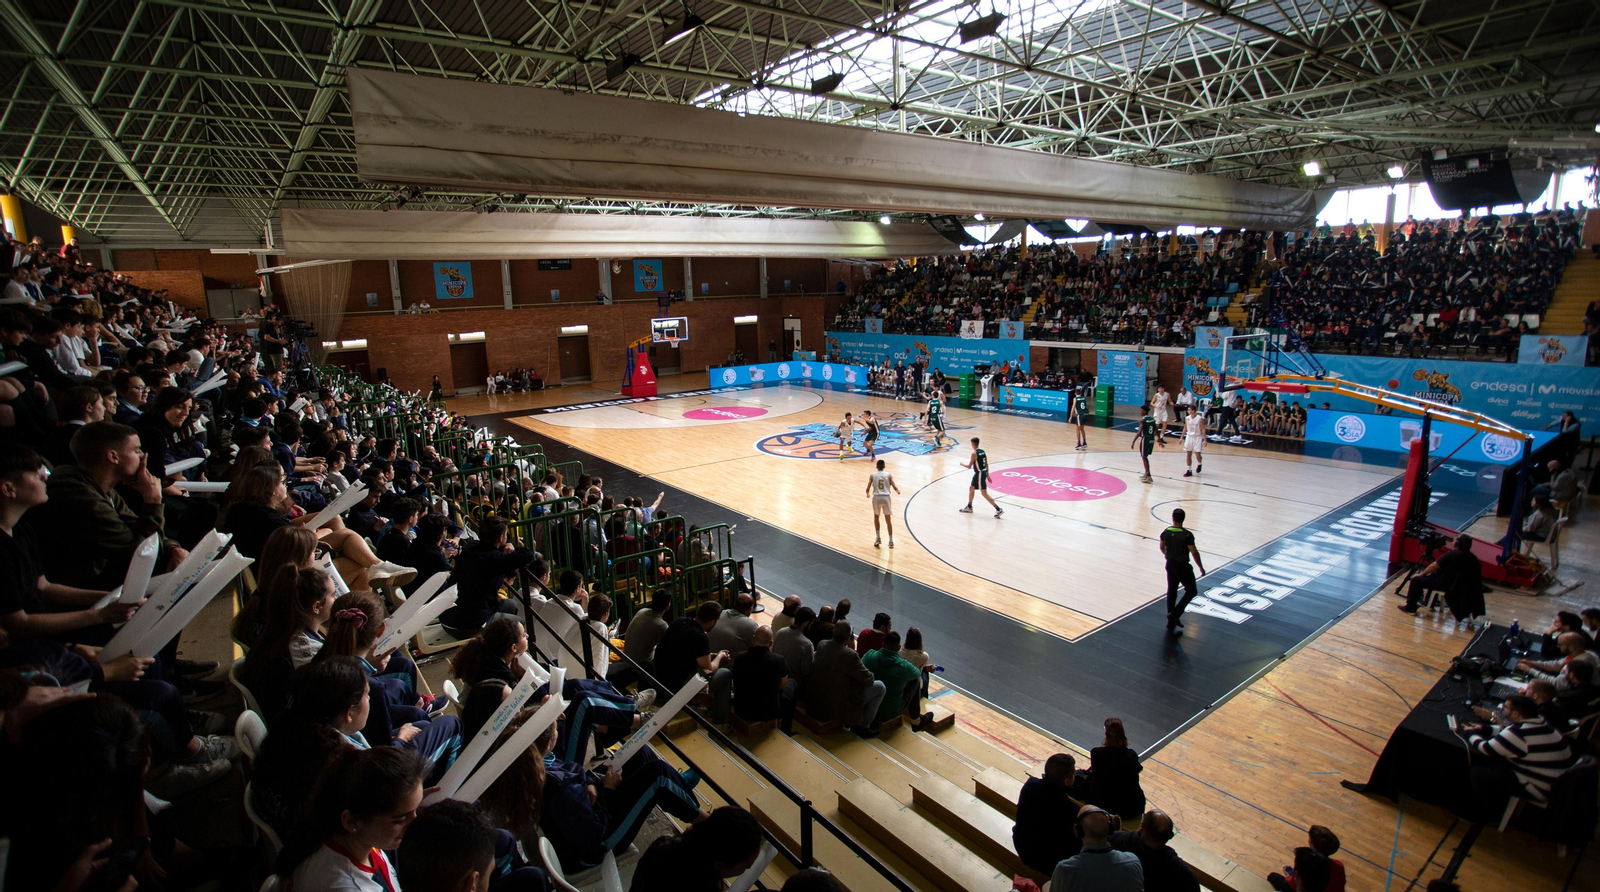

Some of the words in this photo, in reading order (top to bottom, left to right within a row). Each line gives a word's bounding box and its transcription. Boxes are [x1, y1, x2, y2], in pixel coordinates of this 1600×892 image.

[1470, 381, 1527, 393] endesa
[1414, 391, 1459, 402] MINICOPA
[1148, 425, 1153, 434] 8
[1338, 426, 1347, 437] 3
[1486, 442, 1496, 454] 3
[878, 479, 885, 489] 6
[1001, 471, 1110, 497] endesa
[1185, 545, 1351, 624] ENDESA
